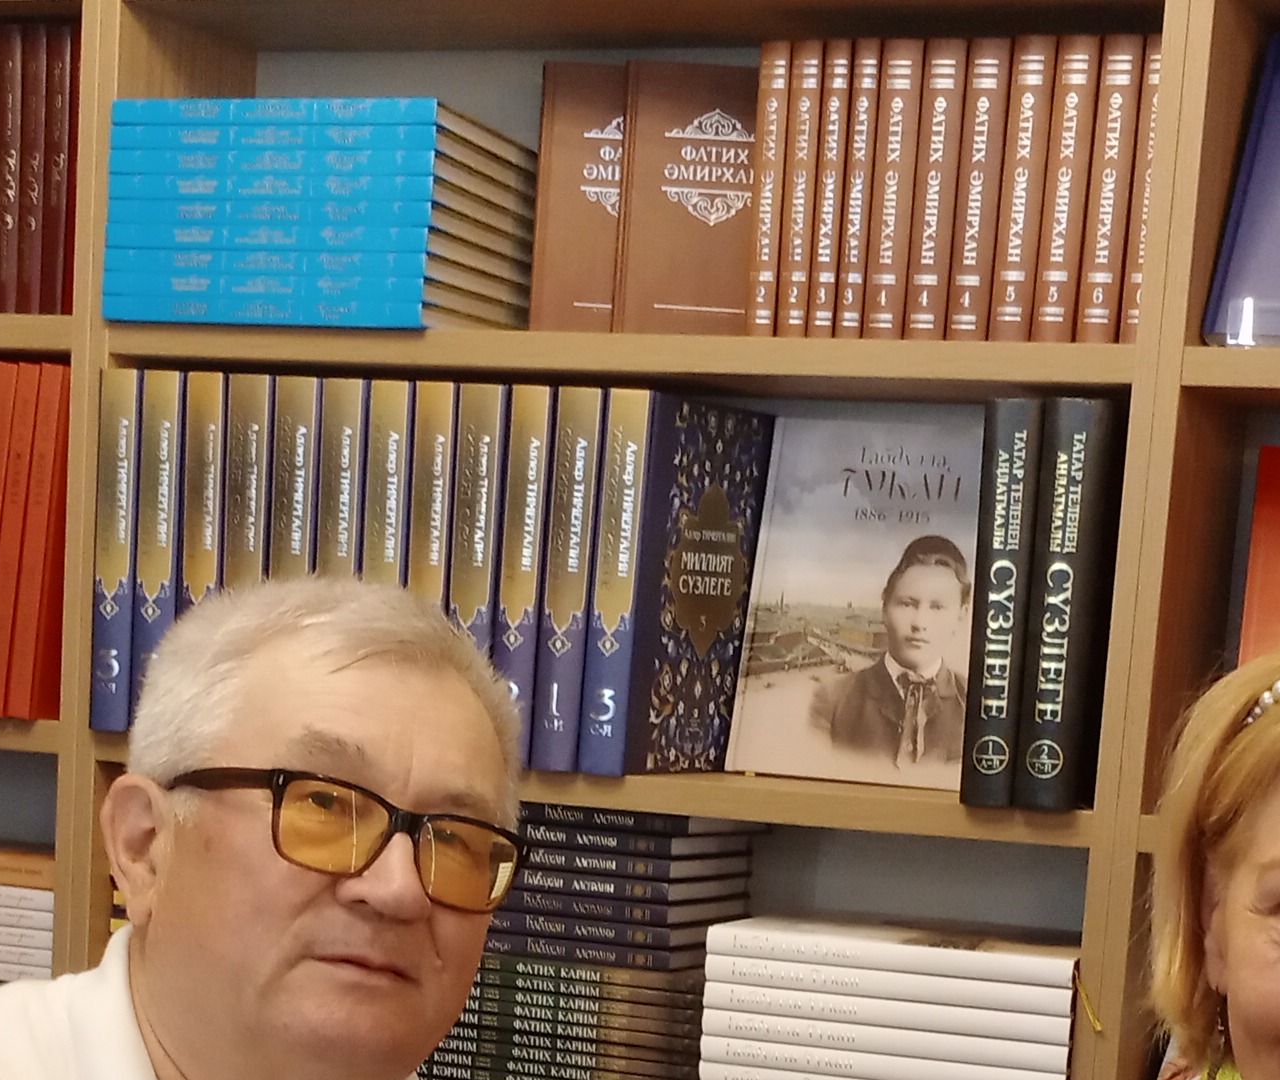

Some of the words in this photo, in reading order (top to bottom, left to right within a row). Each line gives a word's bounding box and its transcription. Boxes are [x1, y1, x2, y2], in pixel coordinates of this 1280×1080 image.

[929, 96, 947, 163] ФАТИХ
[1016, 92, 1035, 161] ФАТИХ
[1059, 92, 1079, 161] ФАТИХ
[1104, 92, 1124, 161] ФАТИХ
[681, 146, 749, 163] ФАТИХ
[921, 171, 941, 265] ӘМИРХАН
[1007, 167, 1028, 263] ӘМИРХАН
[1050, 166, 1072, 263] ӘМИРХАН
[1095, 168, 1116, 264] ӘМИРХАН
[918, 290, 929, 306] 4
[1006, 286, 1015, 302] 5
[1048, 286, 1057, 303] 5
[1093, 287, 1103, 304] 6
[623, 442, 638, 485] Адлер
[1012, 430, 1027, 479] ТАТАР
[1071, 432, 1086, 481] ТАТАР
[681, 552, 734, 573] МИЛЛИЯТ
[981, 559, 1016, 720] СҮЗЛЕГЕ
[1035, 562, 1073, 723] СҮЗЛЕГЕ
[589, 689, 616, 721] 3
[1039, 745, 1048, 759] 2
[515, 993, 554, 1007] ФАТИХ
[559, 998, 599, 1012] КАРИМ
[513, 1019, 552, 1033] ФАТИХ
[557, 1025, 596, 1039] КАРИМ
[507, 1061, 545, 1076] ФАТИХ
[551, 1067, 590, 1080] КАРИМ
